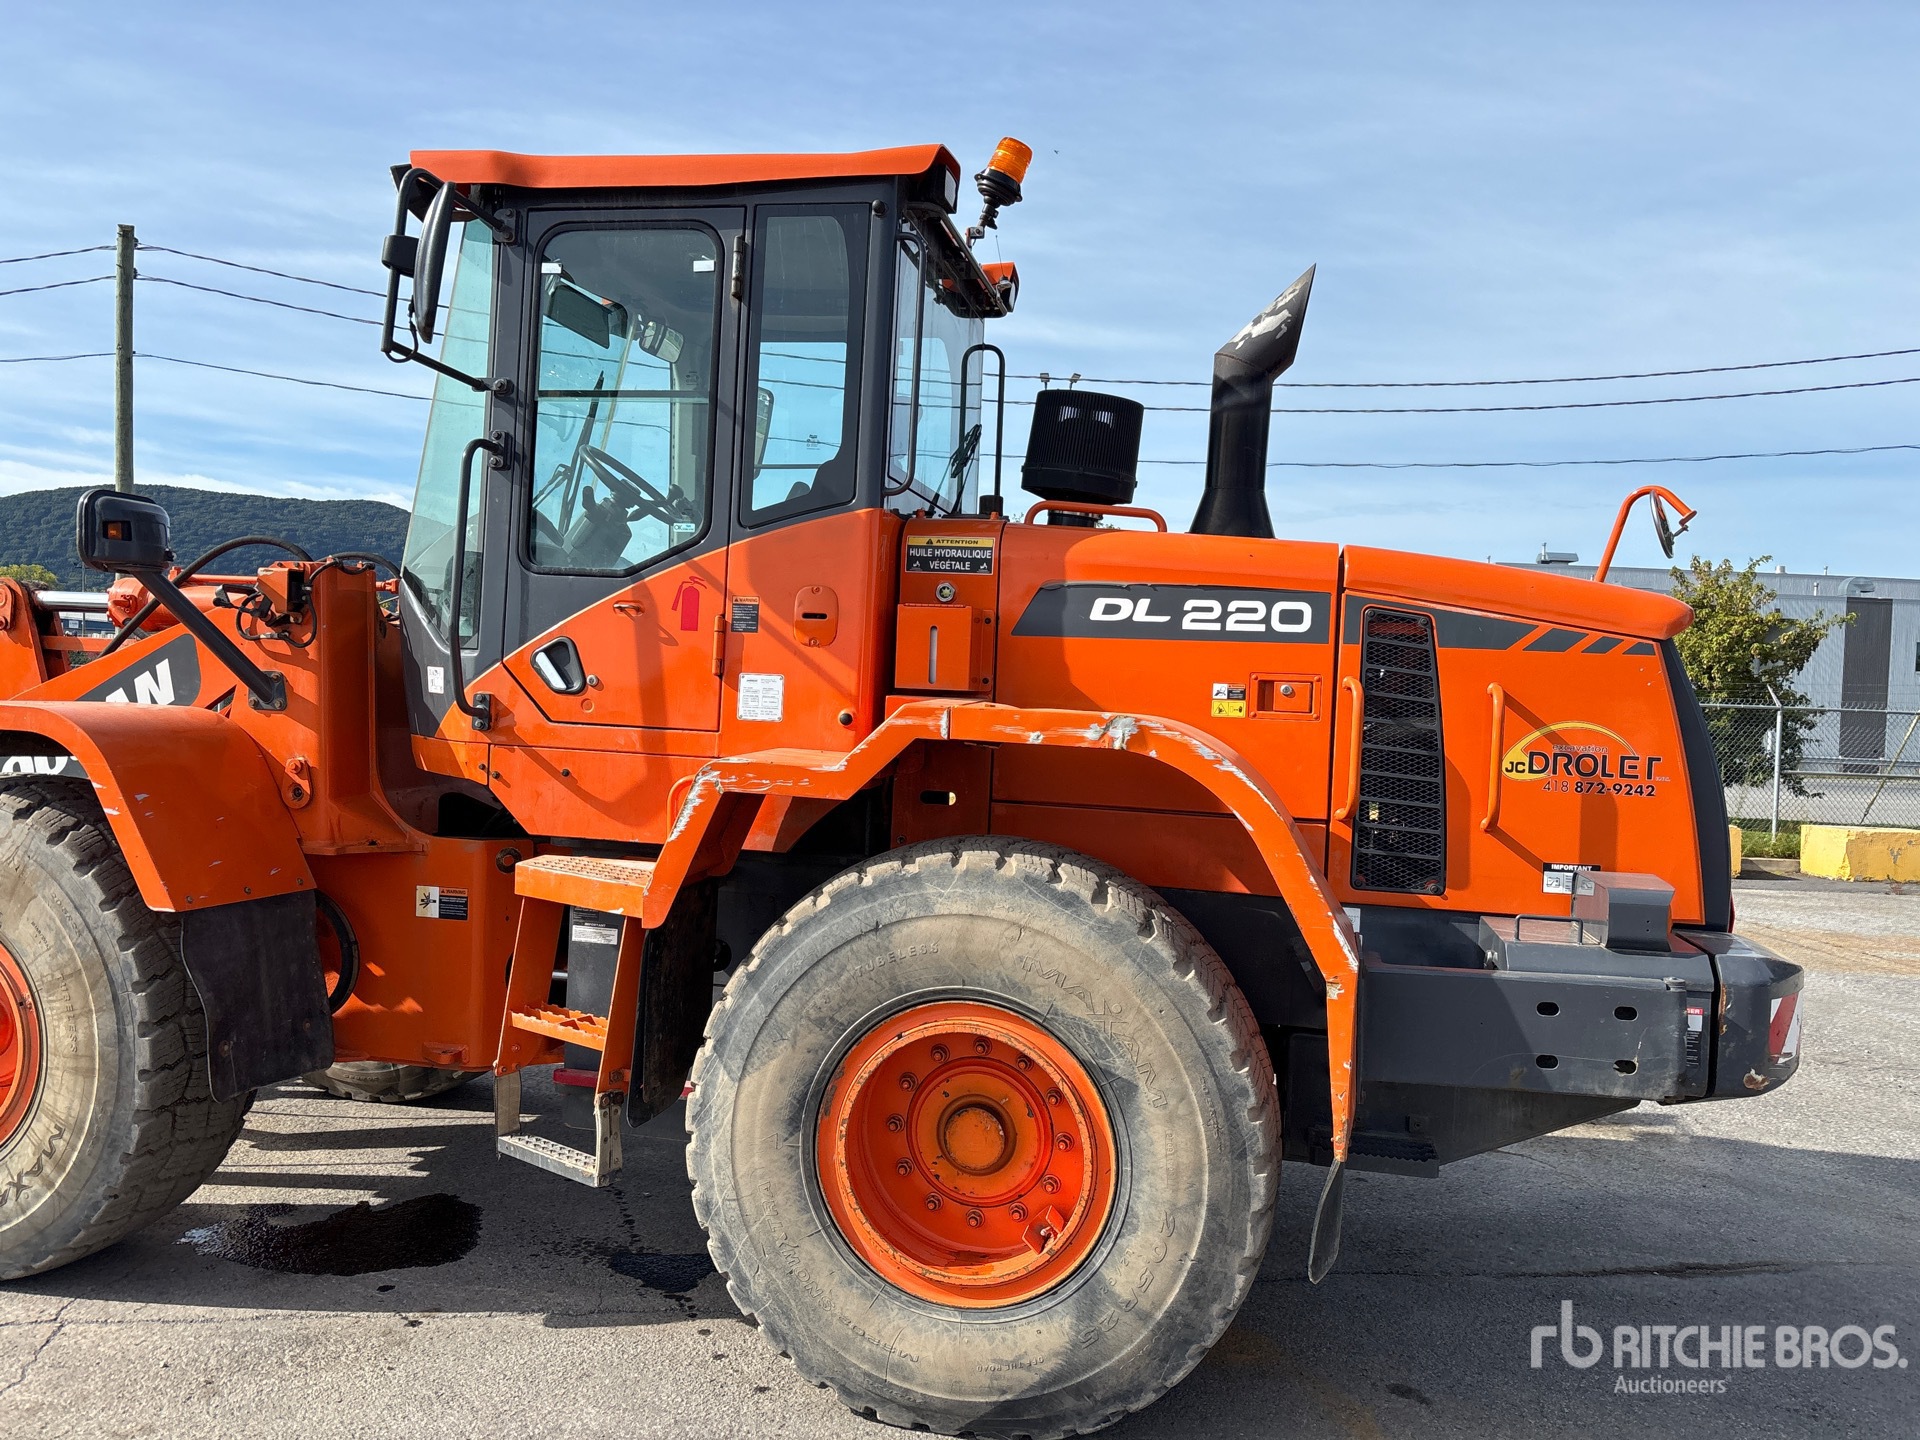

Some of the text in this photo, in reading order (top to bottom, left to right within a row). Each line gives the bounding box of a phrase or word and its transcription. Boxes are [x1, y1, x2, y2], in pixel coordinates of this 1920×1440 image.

[909, 548, 992, 559] HUILE HYDRAULIQUE
[929, 558, 971, 570] VÉGÉTALE
[1089, 597, 1312, 634] DL 220
[1505, 761, 1526, 774] JC
[1528, 751, 1662, 780] DROLET
[1542, 780, 1656, 797] 418 872-9242
[1551, 864, 1593, 872] IMPORTANT
[853, 942, 940, 978] TUBELESS
[1022, 956, 1168, 1108] MAXAM
